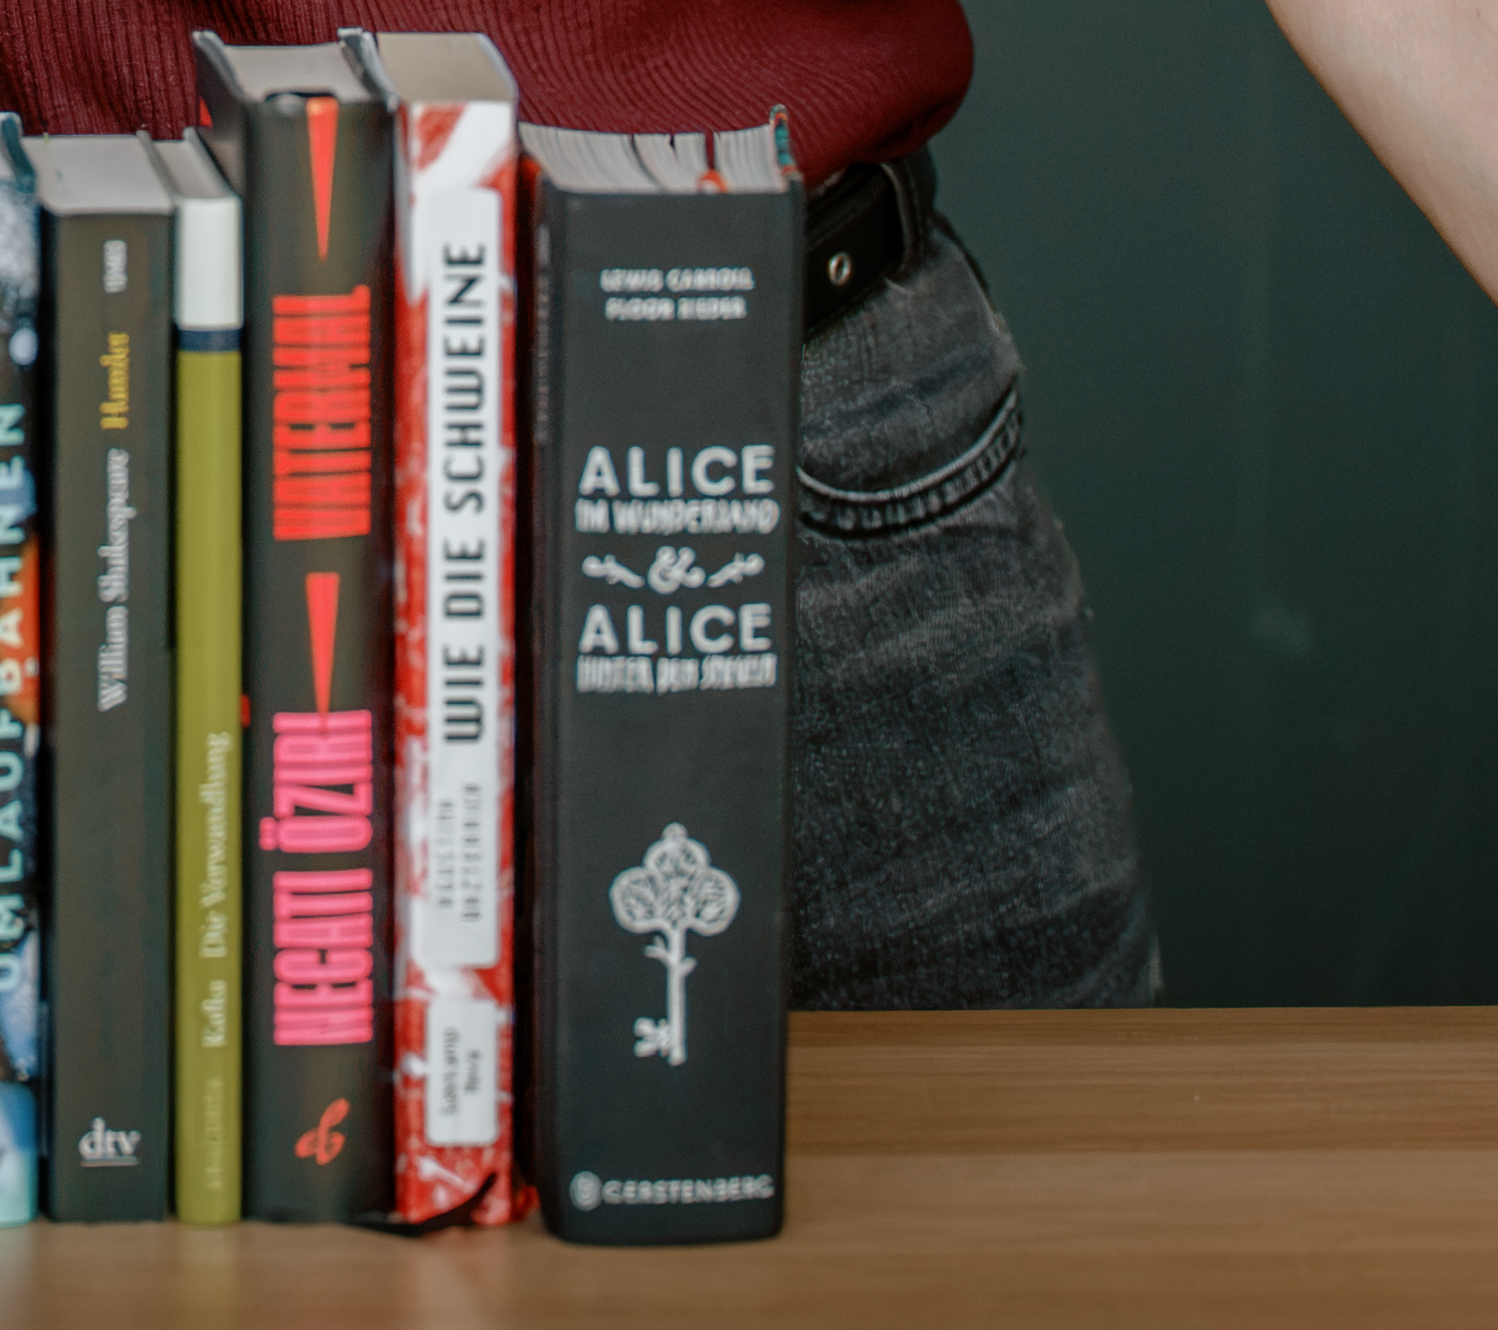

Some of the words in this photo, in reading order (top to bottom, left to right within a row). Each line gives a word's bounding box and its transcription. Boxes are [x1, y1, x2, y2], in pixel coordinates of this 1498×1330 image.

[99, 332, 131, 429] Hamlet
[273, 285, 371, 539] VATERMAL
[443, 241, 486, 516] SCHWEINE
[579, 445, 774, 497] ALICE
[613, 499, 779, 534] WUNDERLAND
[98, 448, 137, 602] Shakespeare
[648, 546, 705, 594] &
[443, 540, 486, 626] DIE
[579, 603, 772, 654] ALICE
[99, 605, 127, 710] William
[443, 646, 486, 746] WIE
[199, 731, 233, 908] Verwandlung
[259, 709, 374, 852] ÖZIRI
[199, 914, 230, 958] Die
[274, 870, 374, 1045] NECATI
[199, 980, 230, 1047] Kafka
[80, 1119, 140, 1159] dtv
[603, 1174, 774, 1204] GERSTENBERG
